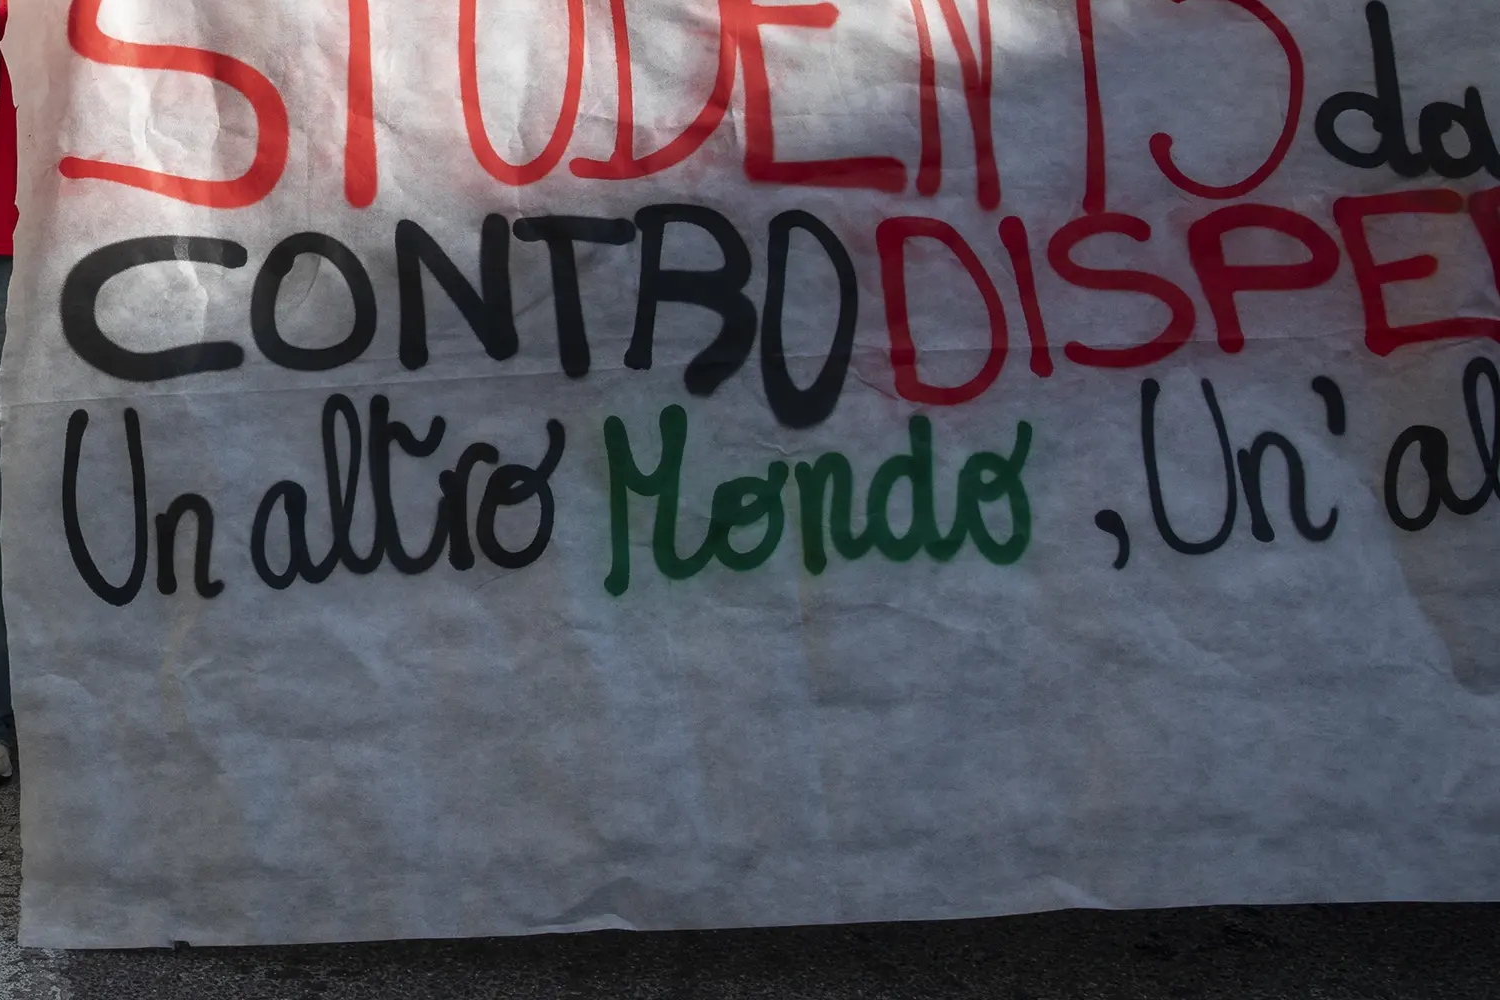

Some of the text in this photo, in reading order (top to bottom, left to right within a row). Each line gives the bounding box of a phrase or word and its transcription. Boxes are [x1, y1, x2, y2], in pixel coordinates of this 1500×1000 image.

[60, 203, 859, 429] CONTRO
[62, 407, 225, 607] Un
[251, 393, 567, 590] altro
[603, 404, 1033, 597] Mondo
